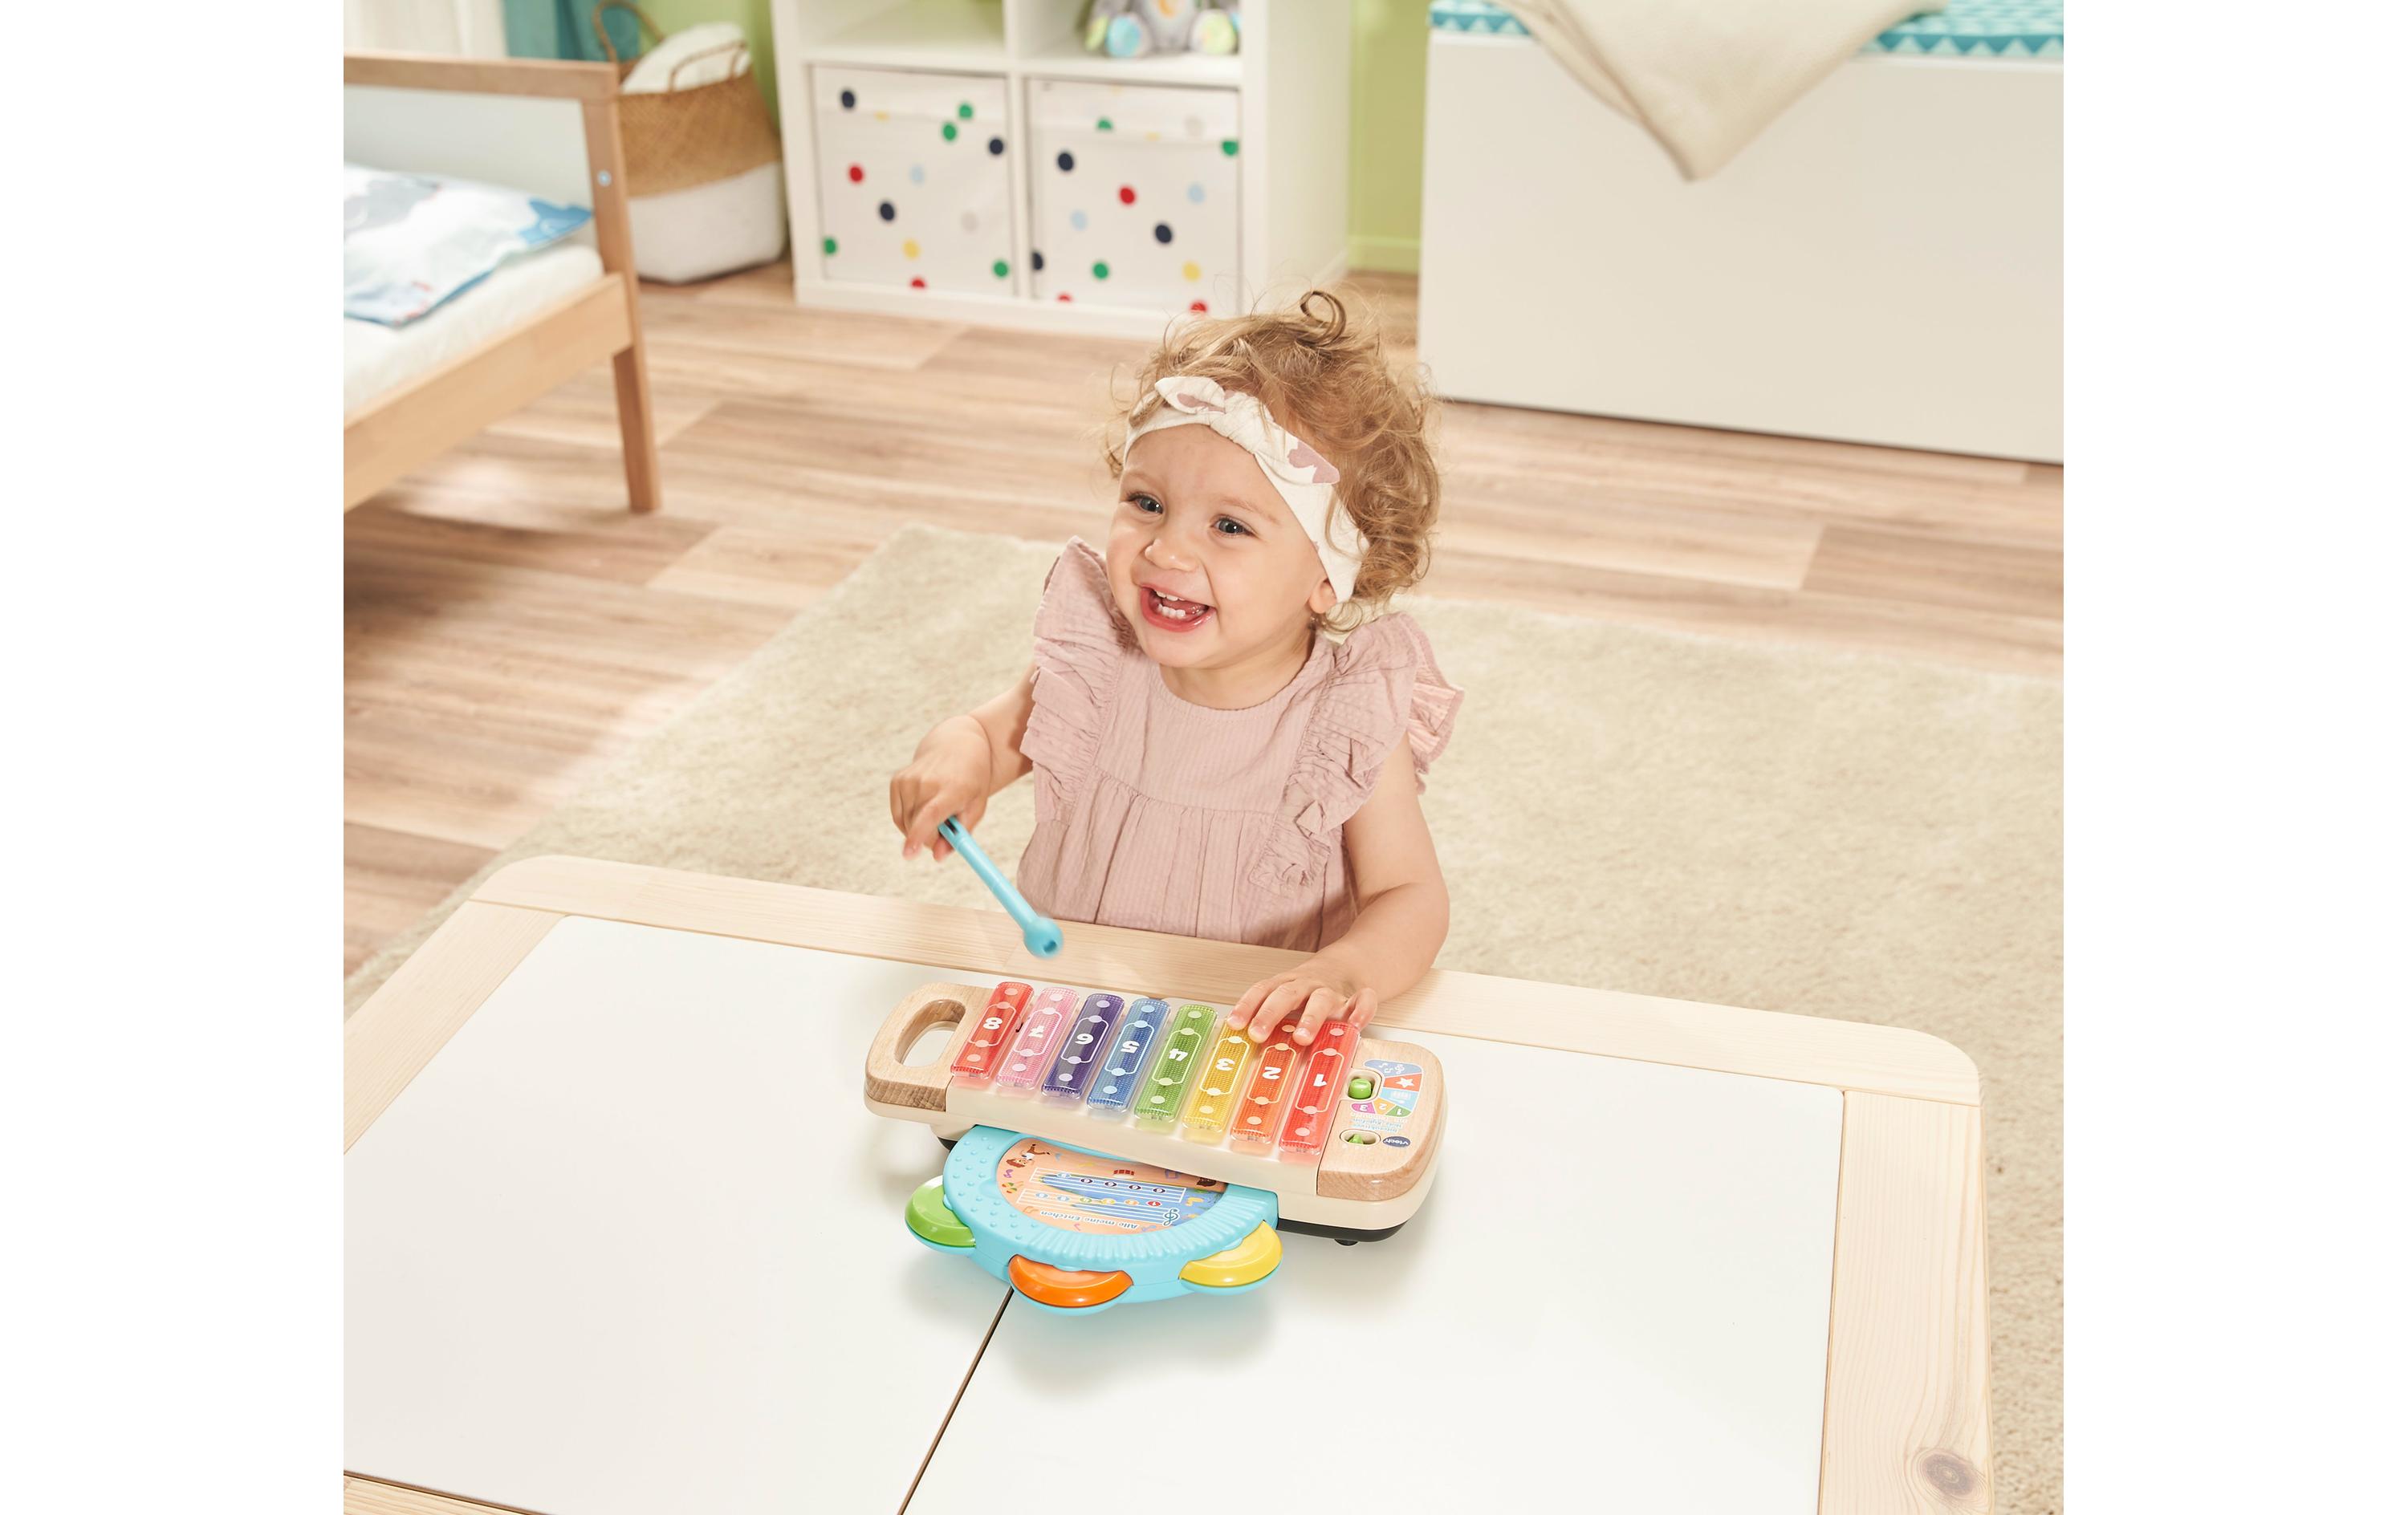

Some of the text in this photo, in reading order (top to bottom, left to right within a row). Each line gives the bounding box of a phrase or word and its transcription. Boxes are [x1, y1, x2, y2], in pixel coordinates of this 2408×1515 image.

[983, 1017, 1003, 1030] 8
[1030, 1025, 1044, 1038] 7
[1075, 1033, 1094, 1045] 6
[1121, 1040, 1140, 1054] 5
[1169, 1048, 1188, 1062] 4
[1215, 1058, 1235, 1070] 3
[1262, 1066, 1282, 1080] 2
[1313, 1074, 1327, 1086] 1
